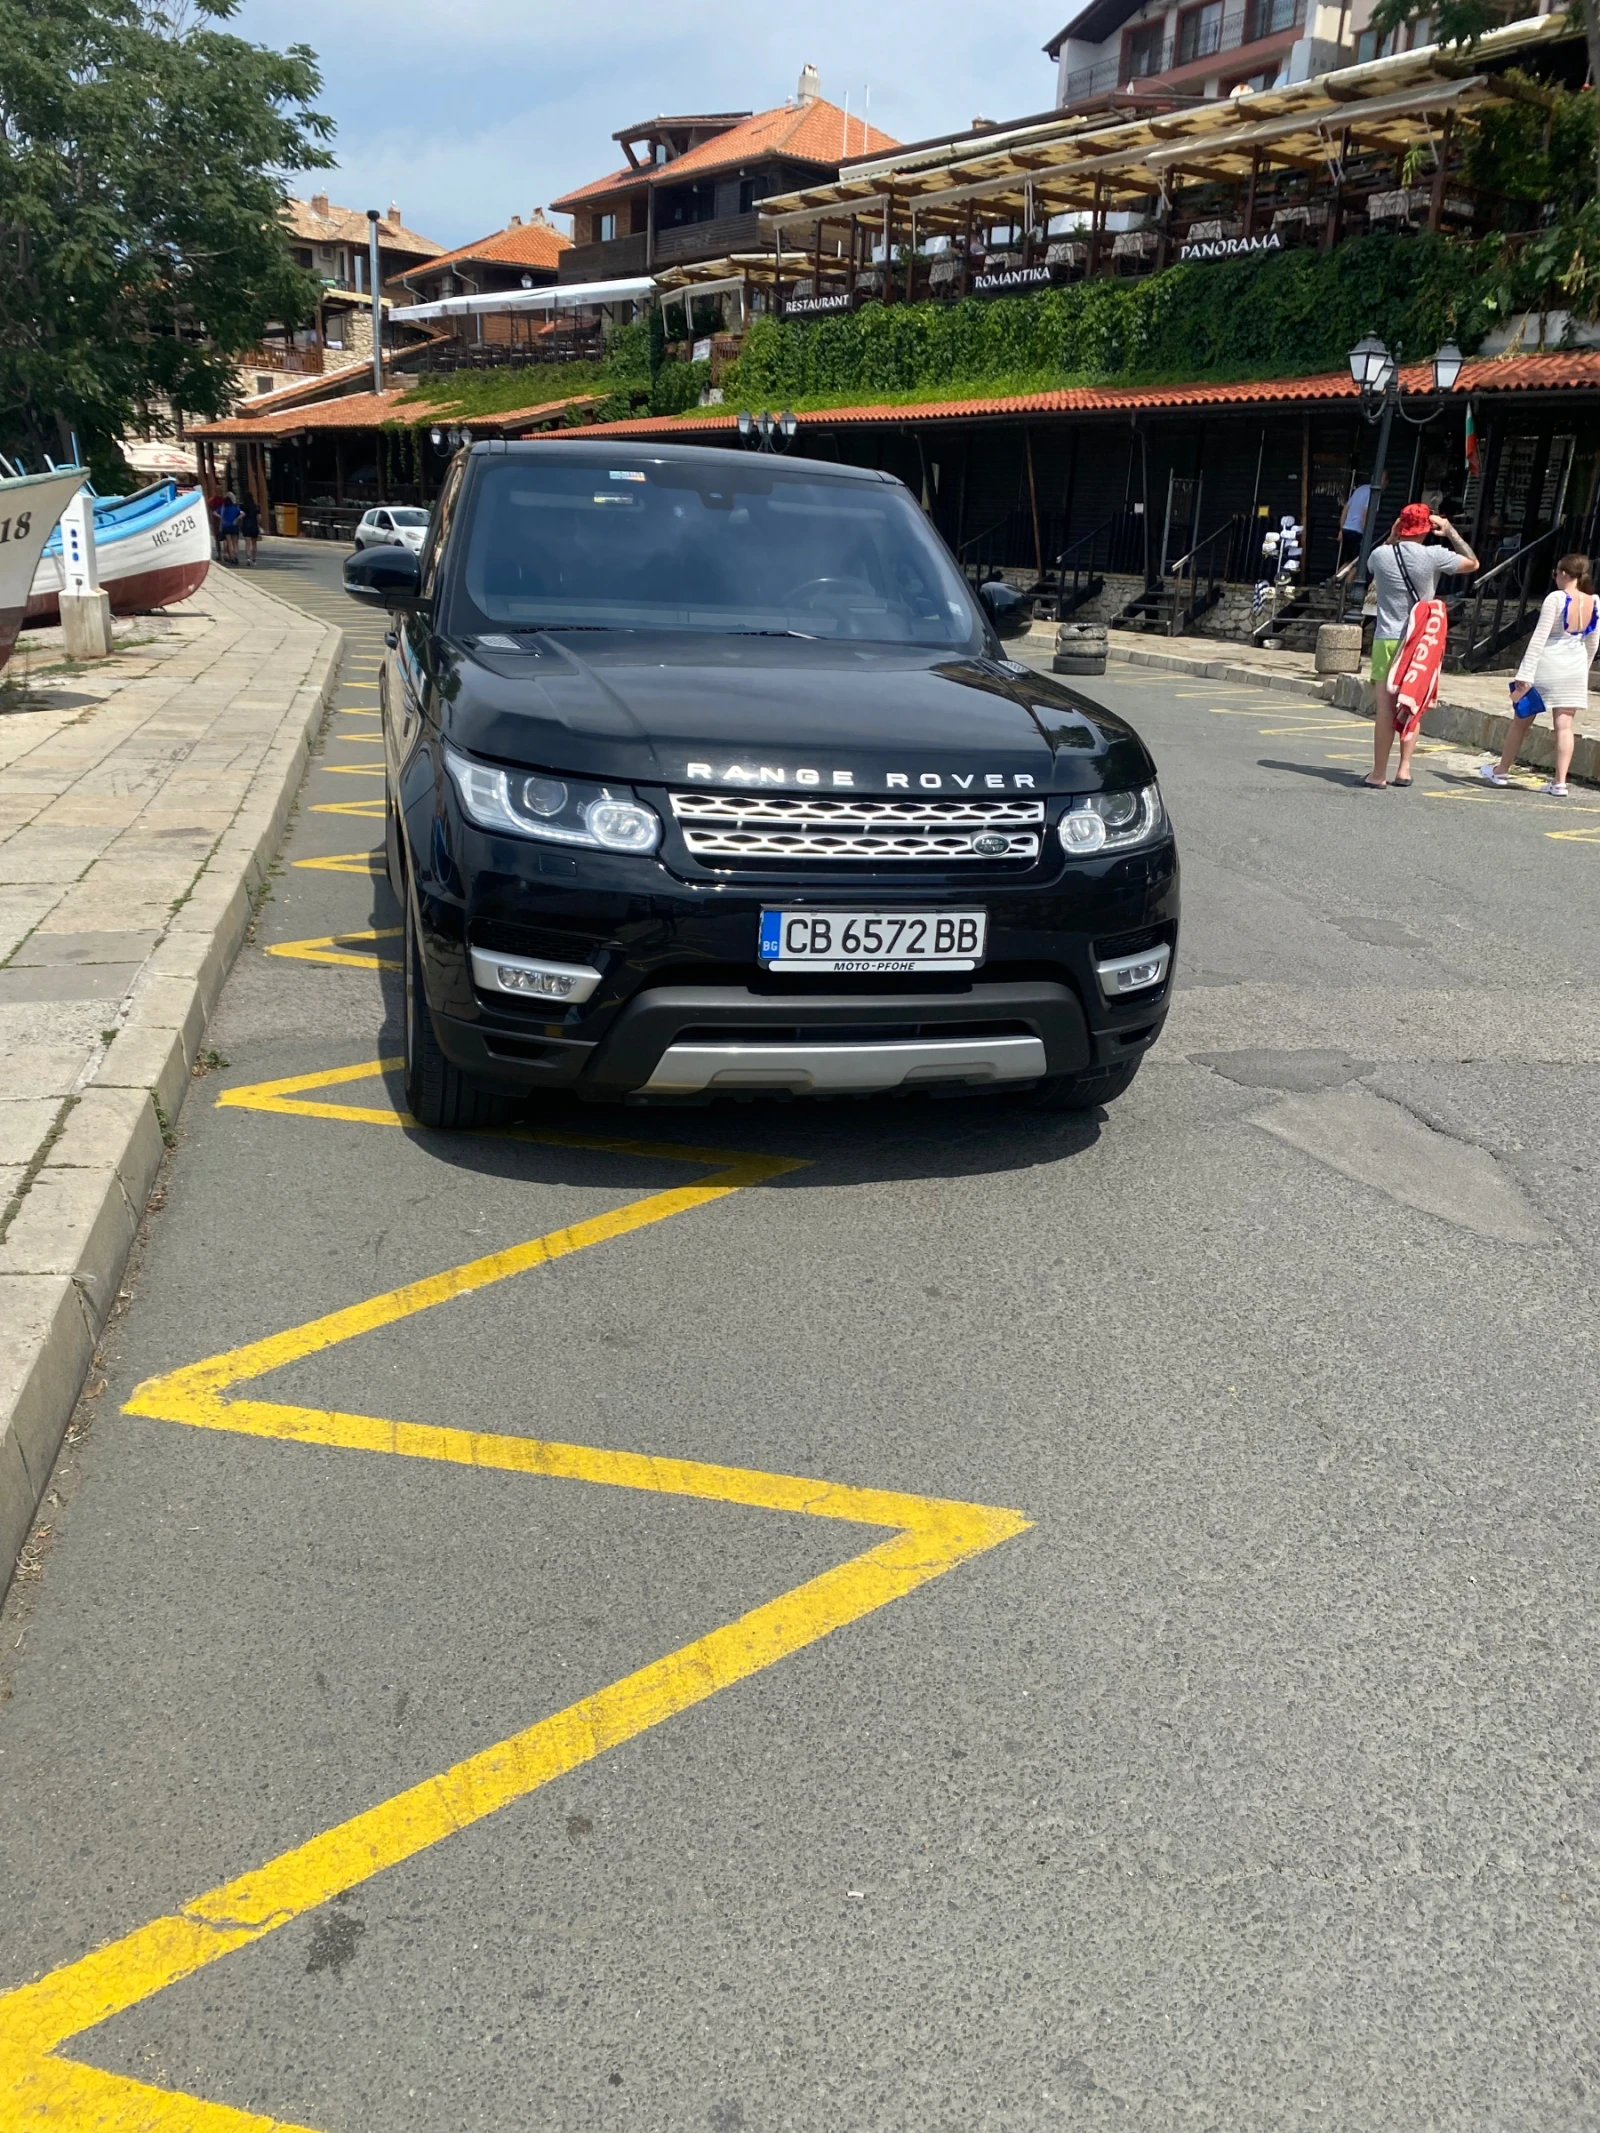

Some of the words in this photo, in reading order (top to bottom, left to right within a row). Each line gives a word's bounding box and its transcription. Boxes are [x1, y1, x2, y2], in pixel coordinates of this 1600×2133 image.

[1180, 232, 1281, 260] PANORAMA
[974, 266, 1051, 289] ROMANTIKA
[785, 293, 850, 313] RESTAURANT
[686, 762, 855, 786] RANGE
[886, 772, 1036, 789] ROVER
[763, 940, 778, 951] BG
[785, 918, 832, 954] CB
[841, 918, 928, 954] 6572
[934, 918, 978, 954] BB
